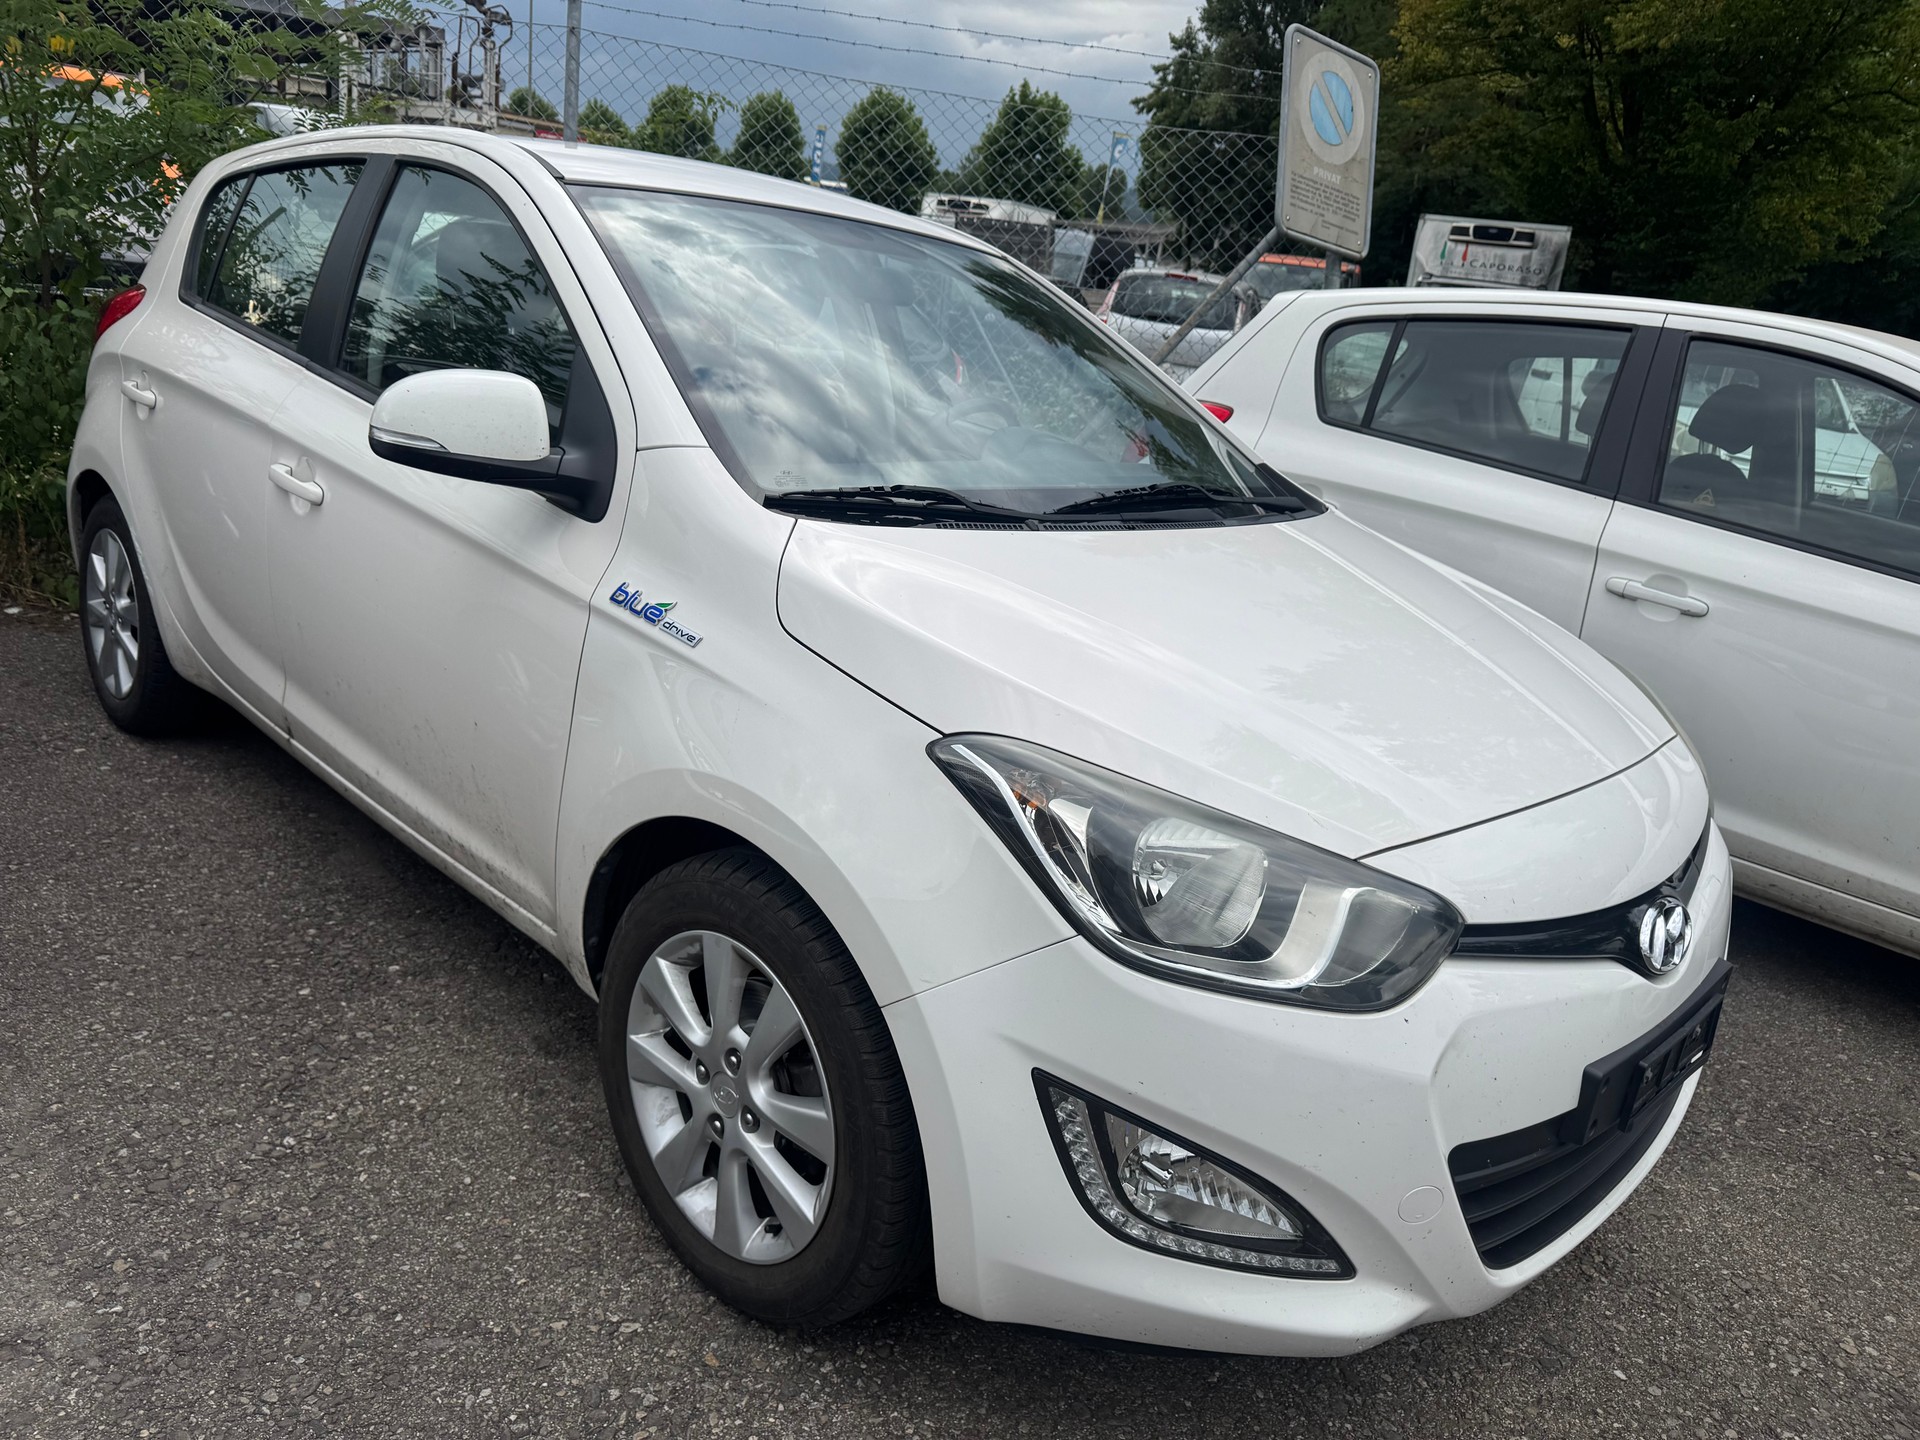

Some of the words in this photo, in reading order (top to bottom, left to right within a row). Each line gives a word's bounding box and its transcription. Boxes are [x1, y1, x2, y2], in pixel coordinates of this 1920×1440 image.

[1313, 166, 1342, 185] PRIVAT
[1469, 258, 1543, 276] CAPORASO
[609, 581, 666, 626] blue
[662, 621, 697, 643] drive
